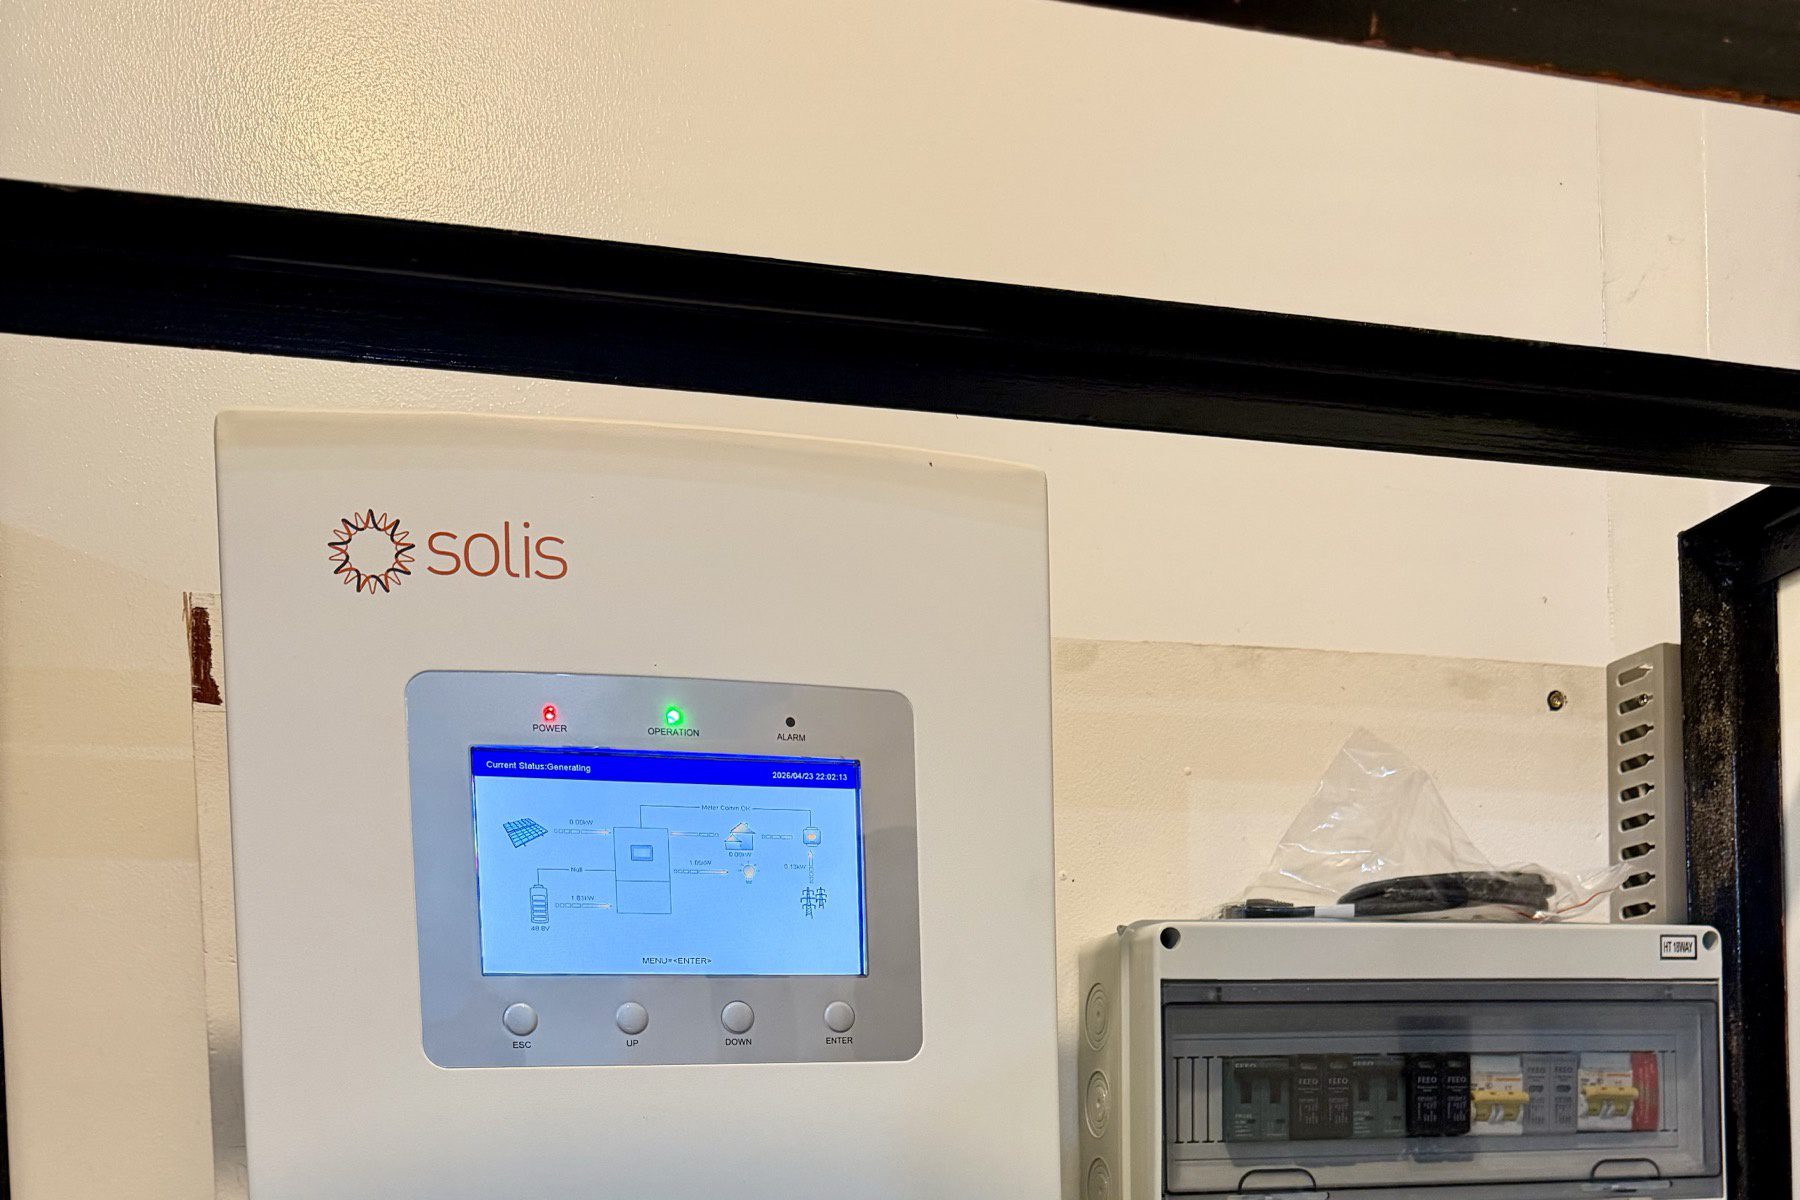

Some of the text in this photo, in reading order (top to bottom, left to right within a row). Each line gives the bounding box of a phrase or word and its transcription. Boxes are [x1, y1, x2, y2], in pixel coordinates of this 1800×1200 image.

[427, 520, 569, 580] solis
[532, 723, 568, 733] POWER
[647, 727, 700, 738] OPERATION
[777, 733, 806, 743] ALARM
[486, 760, 592, 774] Current Status:Generating
[772, 771, 848, 781] 2026/04/23 22:02:13
[1664, 941, 1672, 953] HT
[512, 1040, 532, 1049] ESC
[626, 1039, 639, 1047] UP
[725, 1038, 752, 1046] DOWN
[825, 1036, 854, 1045] ENTER
